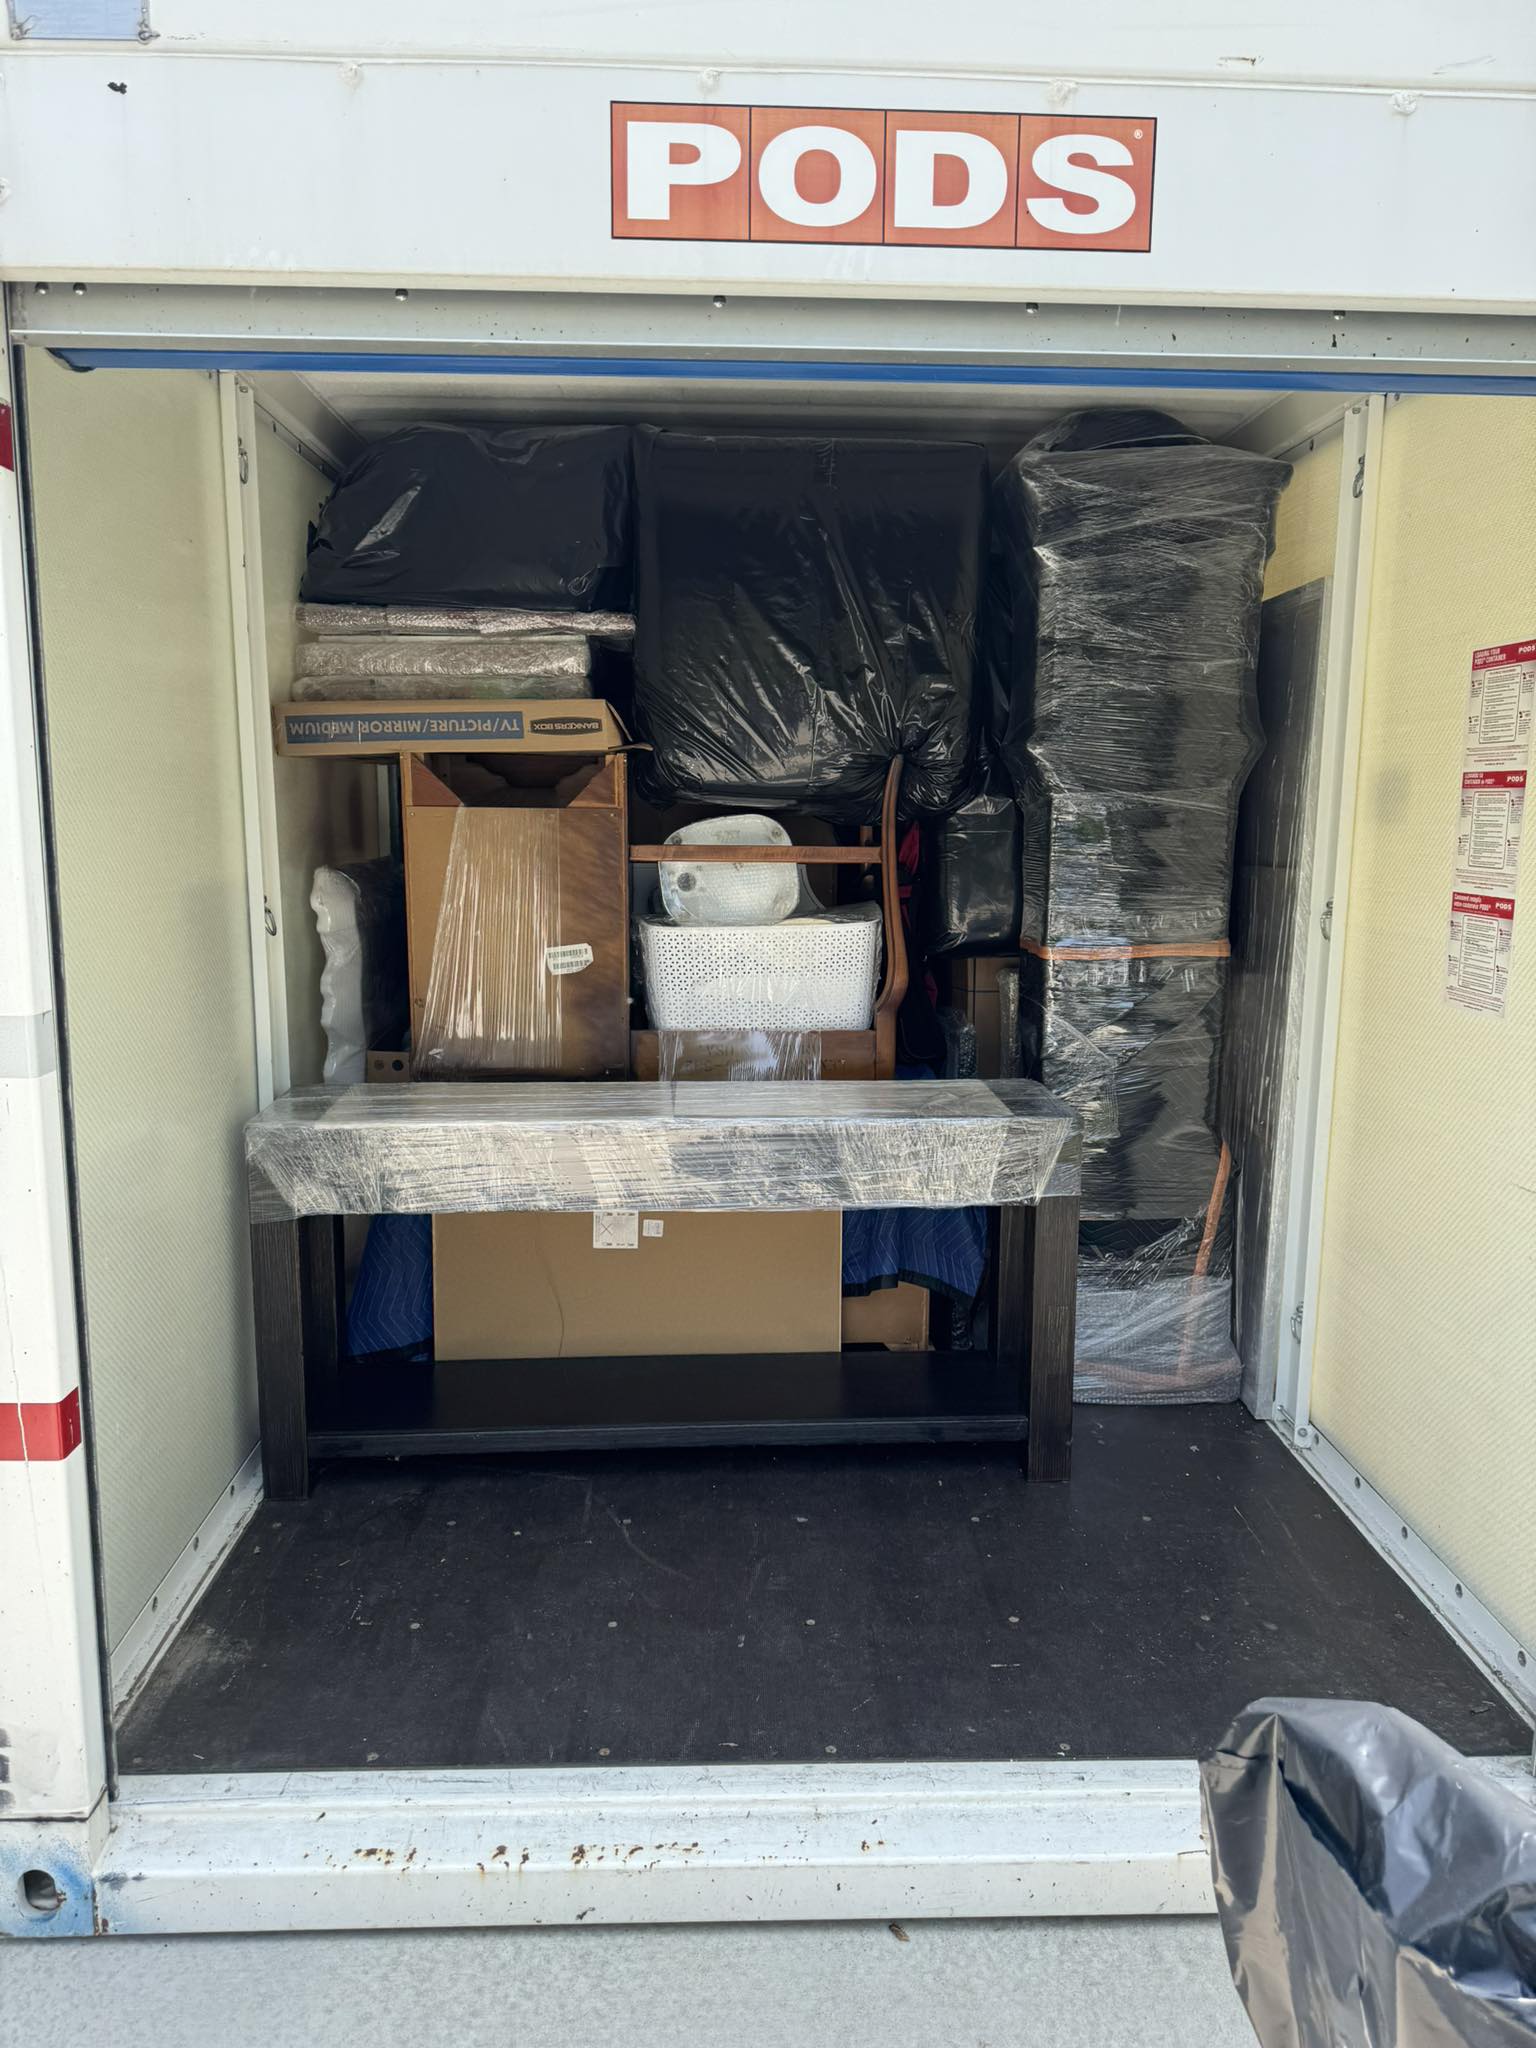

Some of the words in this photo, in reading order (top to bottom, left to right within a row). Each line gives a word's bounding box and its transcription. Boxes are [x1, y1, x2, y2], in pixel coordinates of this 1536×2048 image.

[289, 720, 354, 736] MEDIUM
[359, 716, 520, 735] TV/PICTURE/MIRROR
[533, 723, 554, 731] BOX
[555, 721, 600, 730] BANKERS
[1506, 775, 1524, 783] PODS
[1495, 902, 1513, 911] PODS
